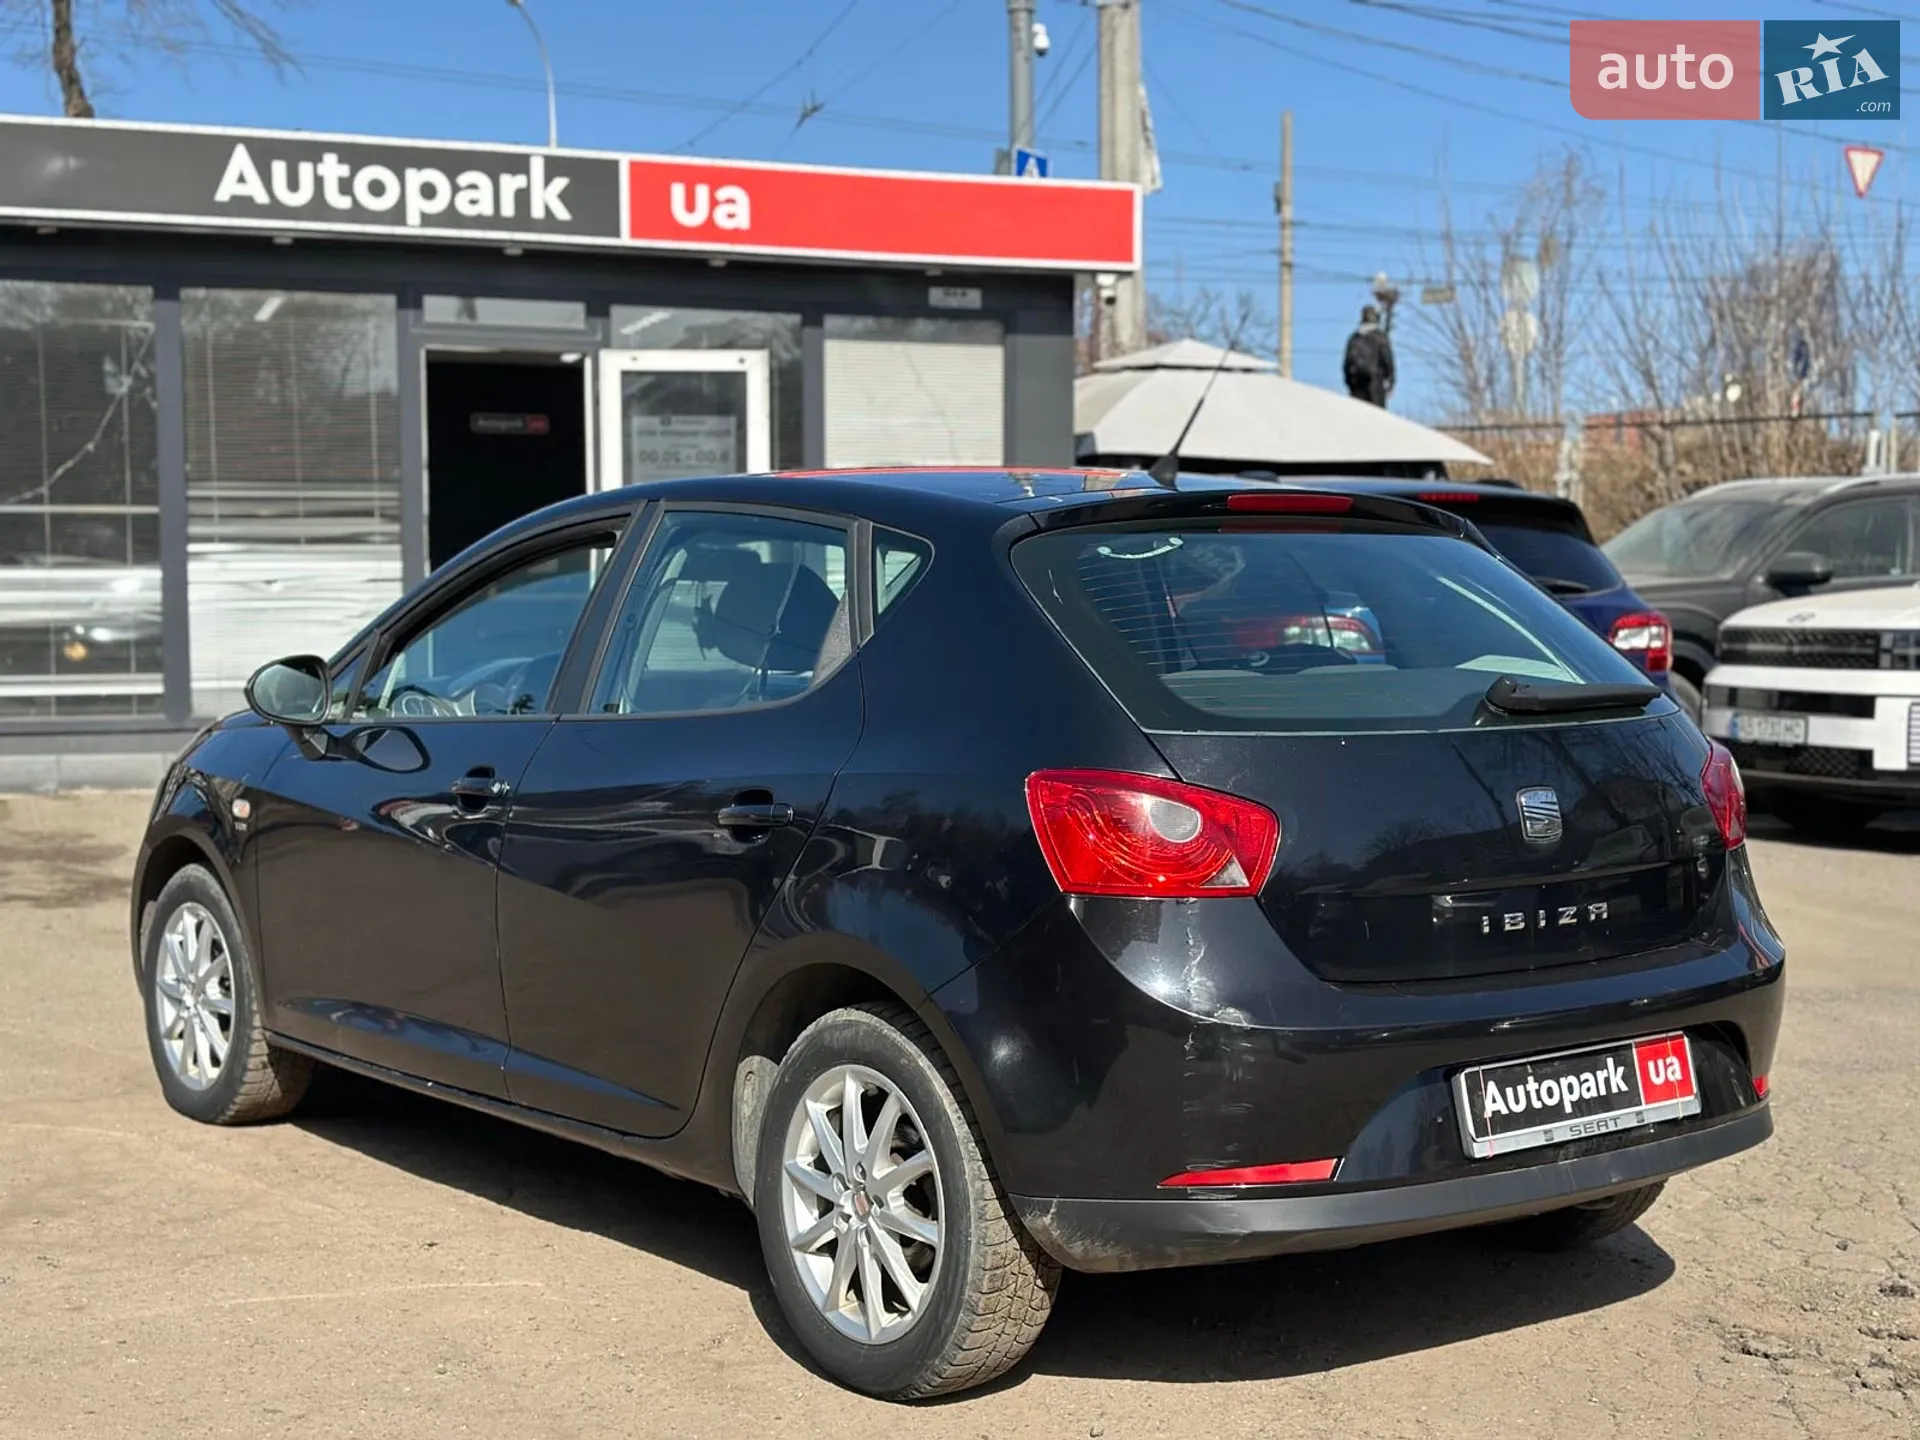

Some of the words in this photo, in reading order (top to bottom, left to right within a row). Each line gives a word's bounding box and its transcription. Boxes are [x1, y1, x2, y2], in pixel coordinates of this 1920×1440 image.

[214, 143, 573, 226] Autopark
[670, 182, 752, 231] ua
[1481, 902, 1609, 934] IBIZA
[1483, 1057, 1629, 1119] Autopark
[1647, 1055, 1683, 1086] ua
[1569, 1116, 1621, 1138] SEAT
